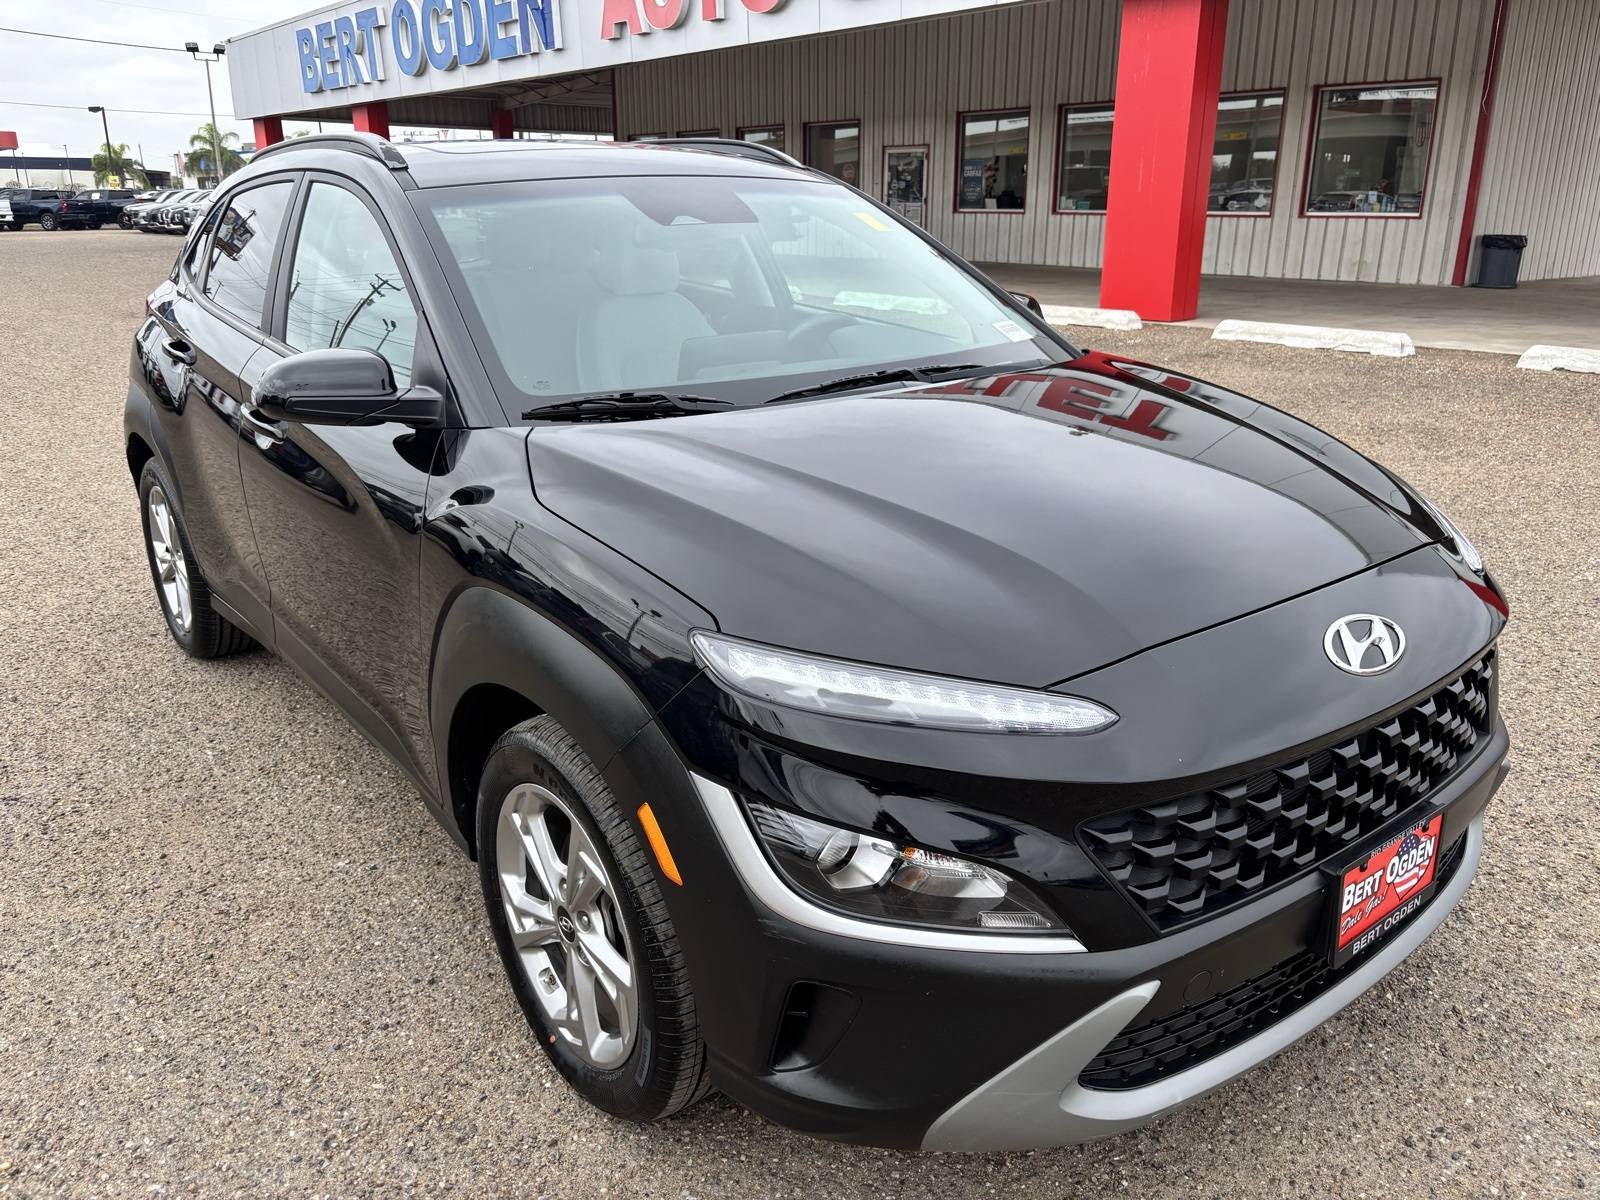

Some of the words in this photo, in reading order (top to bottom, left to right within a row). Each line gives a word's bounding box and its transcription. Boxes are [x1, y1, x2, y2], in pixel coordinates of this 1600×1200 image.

[296, 7, 386, 93] BERT
[391, 0, 564, 76] OGDEN
[1341, 868, 1384, 914] BERT
[1385, 835, 1435, 884] OGDEN
[1352, 924, 1383, 955] BERT
[1383, 894, 1422, 931] OGDEN
